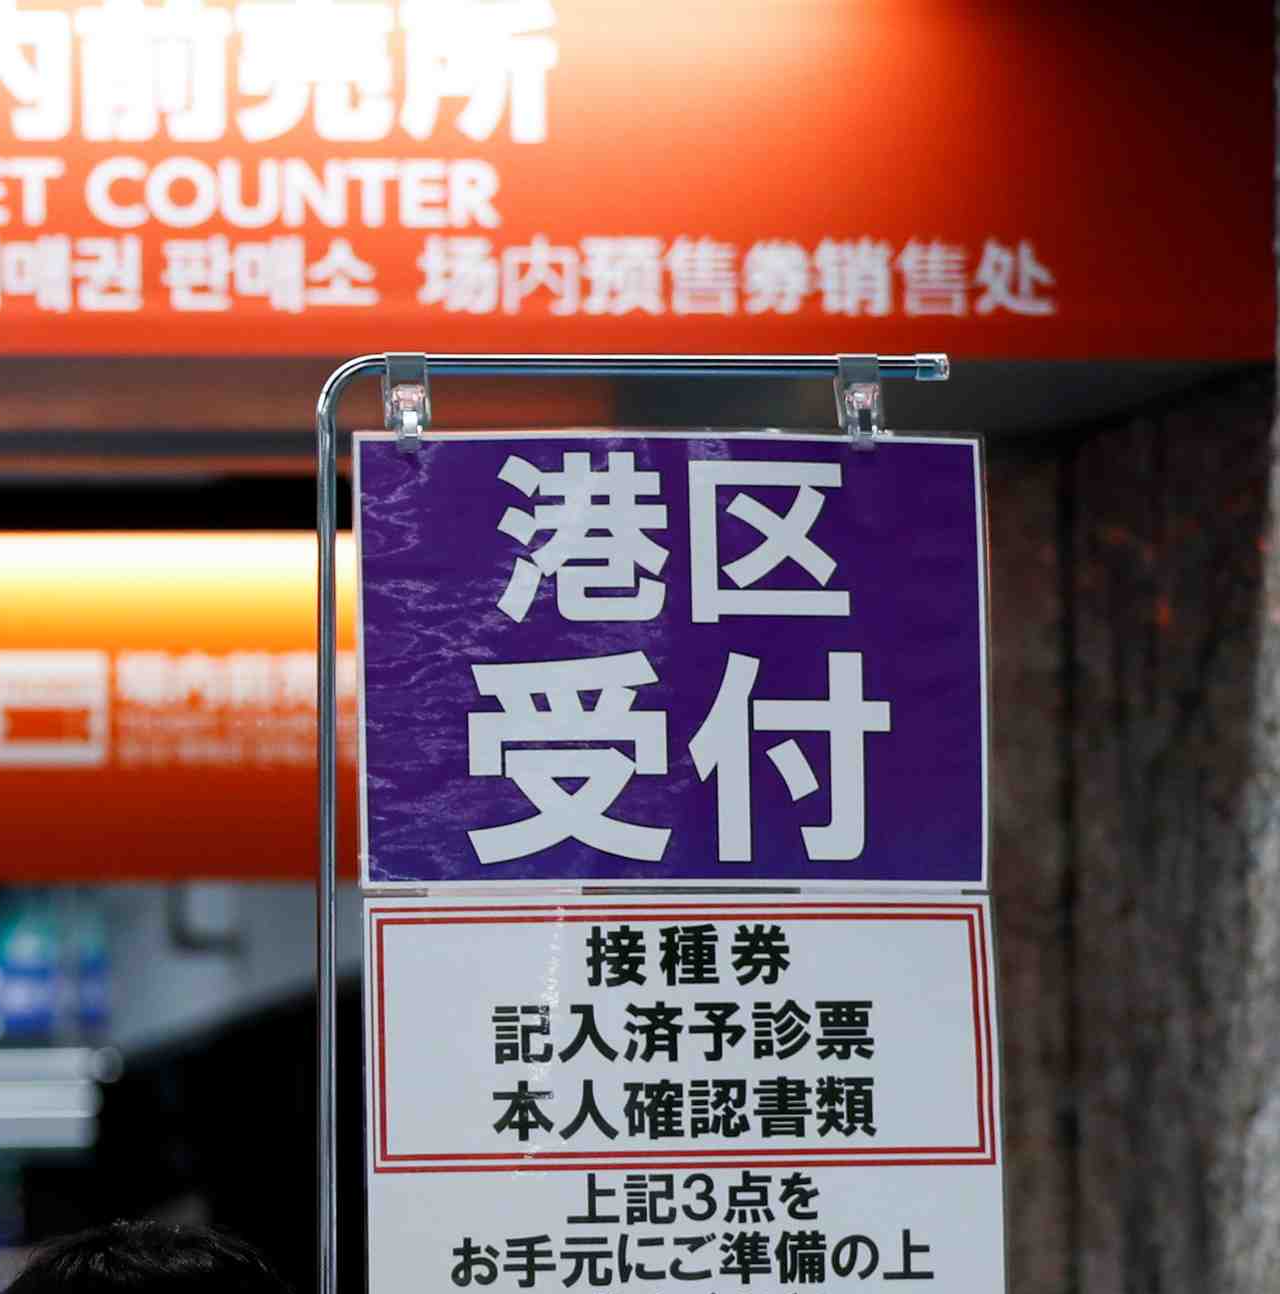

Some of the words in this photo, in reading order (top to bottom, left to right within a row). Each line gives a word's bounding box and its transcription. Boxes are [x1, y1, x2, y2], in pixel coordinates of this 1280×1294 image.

[84, 155, 501, 229] COUNTER
[161, 234, 379, 314] 판매소
[495, 450, 852, 625] 港区
[465, 649, 893, 866] 受付
[585, 924, 792, 988] 接種券
[491, 999, 876, 1065] 記入済予診票
[491, 1075, 878, 1141] 本人確認書類
[566, 1170, 820, 1226] 上記3点を
[449, 1228, 936, 1289] お手元にご準備の上
